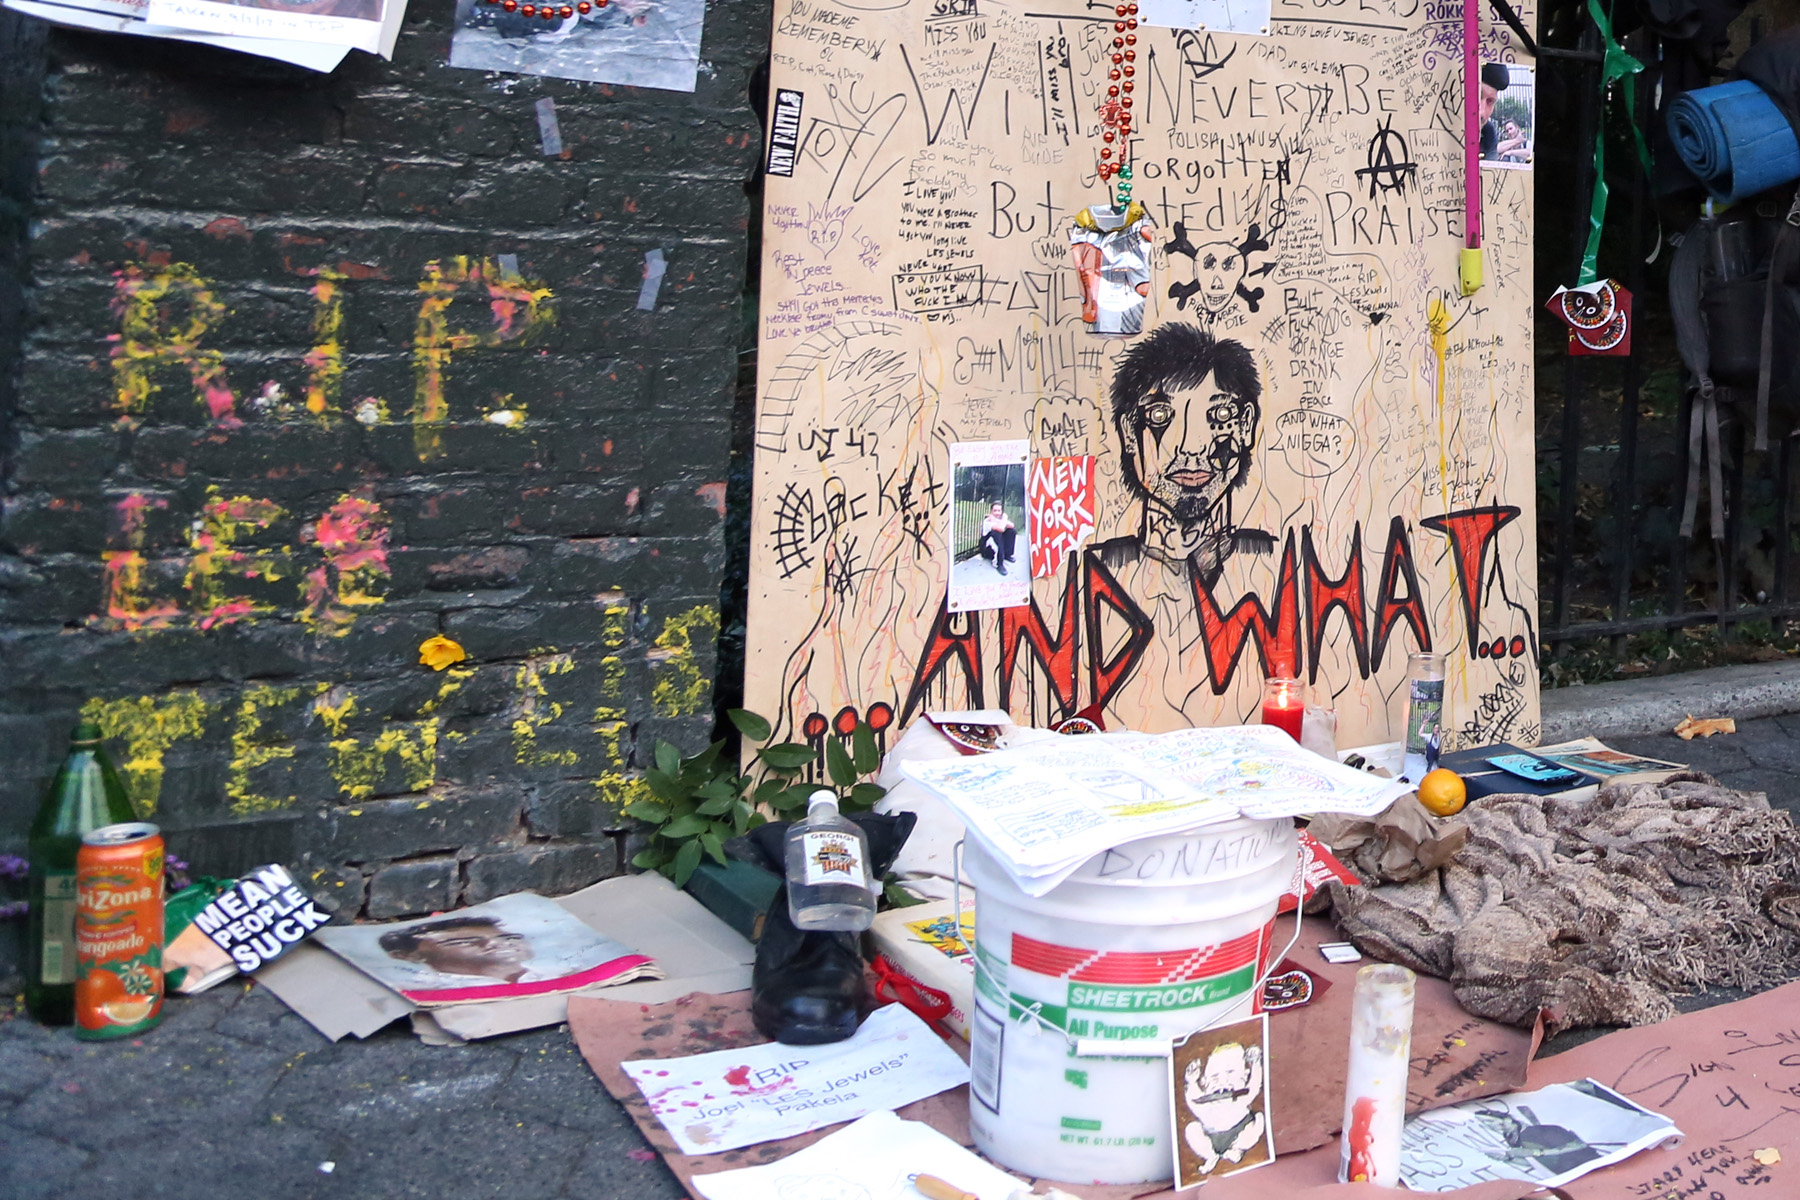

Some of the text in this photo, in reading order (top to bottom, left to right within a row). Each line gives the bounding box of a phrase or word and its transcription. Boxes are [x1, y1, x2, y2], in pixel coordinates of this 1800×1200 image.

[768, 103, 802, 177] NEW FAITH
[1029, 456, 1090, 500] NEW
[1029, 492, 1094, 548] YORK
[810, 832, 855, 843] GEORGI
[77, 886, 153, 911] riZona
[194, 863, 293, 935] MEAN
[212, 885, 309, 950] PEOPLE
[231, 901, 332, 974] SUCK
[1070, 984, 1208, 1010] SHEETROCK
[1068, 1017, 1160, 1043] All Purpose
[754, 1058, 811, 1086] RIP
[693, 1100, 746, 1121] Joel
[775, 1092, 860, 1118] Pakela
